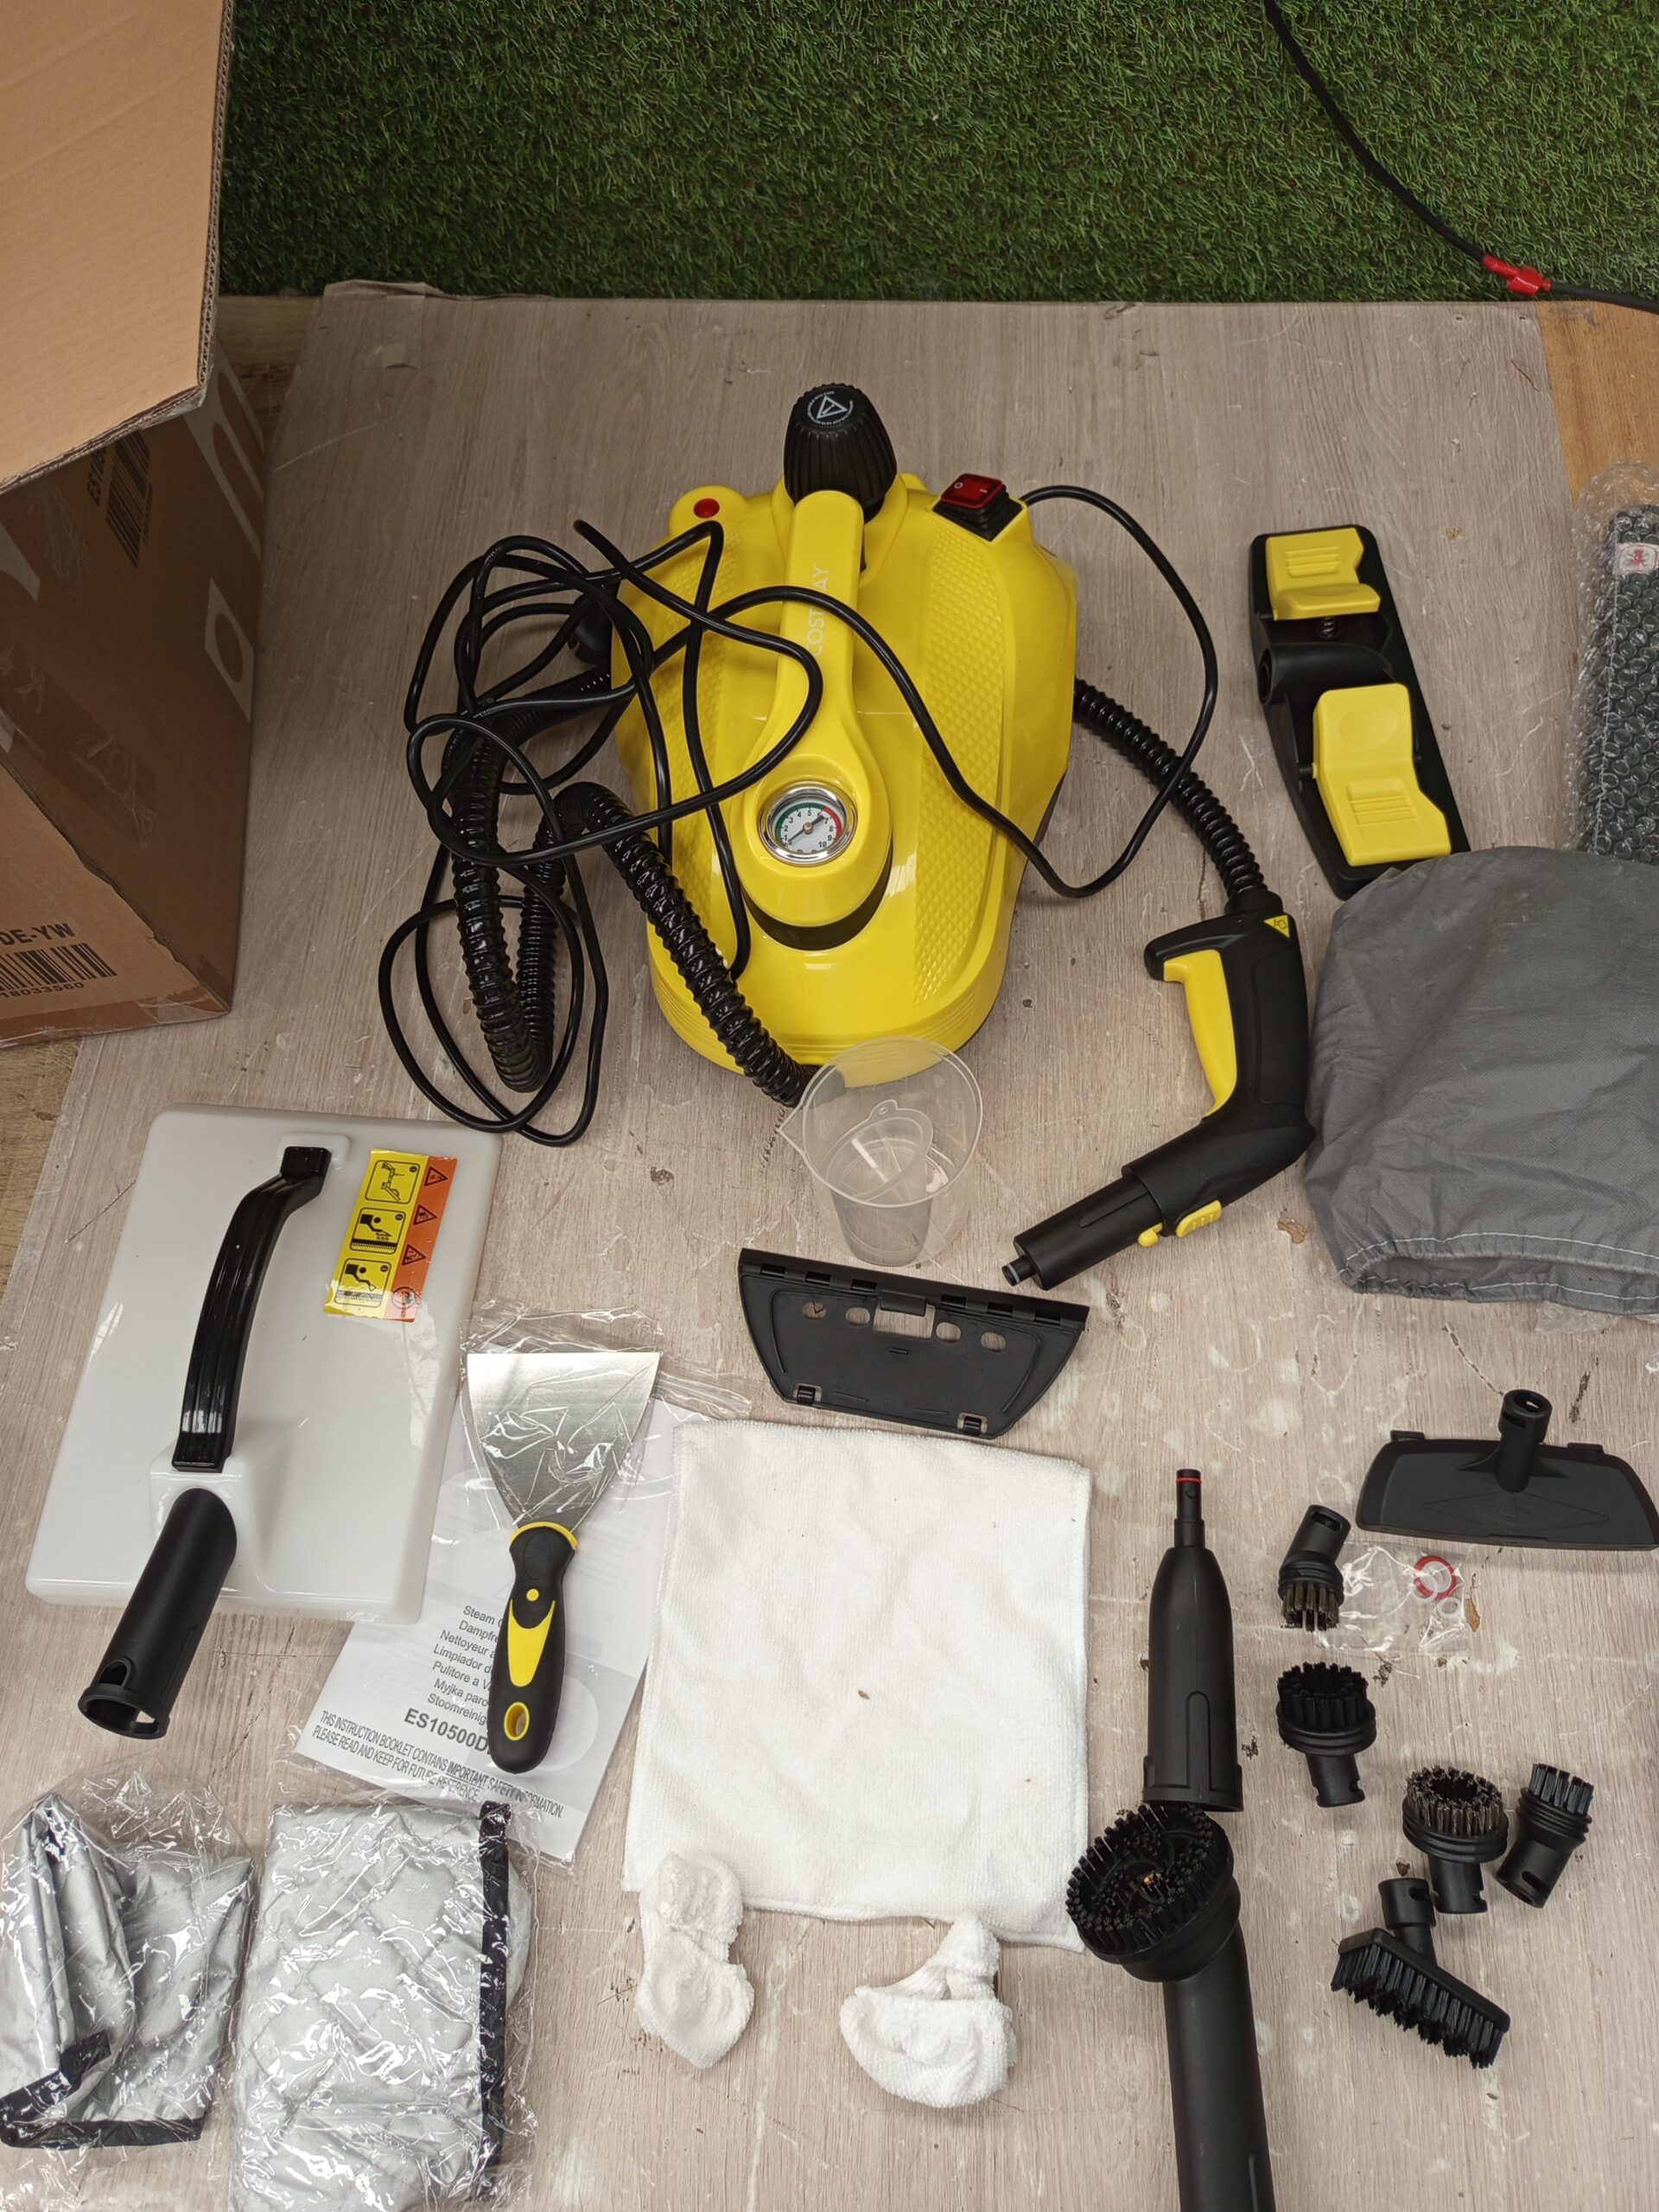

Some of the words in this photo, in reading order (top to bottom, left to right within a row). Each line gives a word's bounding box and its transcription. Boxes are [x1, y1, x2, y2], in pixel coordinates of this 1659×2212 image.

[806, 565, 830, 657] COSTAY
[463, 1605, 495, 1624] Steam
[433, 1643, 483, 1669] Limpiador
[484, 1664, 493, 1674] d
[440, 1630, 489, 1656] Nettoyeur
[432, 1661, 471, 1682] Pulitore
[483, 1679, 491, 1690] V
[434, 1678, 464, 1697] Myjka
[404, 1707, 490, 1754] ES10500D
[312, 1725, 340, 1745] PLEASE
[338, 1735, 359, 1753] READ
[356, 1743, 375, 1759] AND
[372, 1750, 394, 1766] KEEP
[392, 1757, 410, 1774] FOR
[408, 1763, 438, 1785] FUTURE
[320, 1710, 336, 1726] THIS
[334, 1716, 381, 1745] INSTRUCTION
[378, 1734, 414, 1756] BOOKLET
[412, 1747, 448, 1771] CONTAINS
[446, 1761, 488, 1788] IMPORTANT
[486, 1777, 517, 1798] SAFETY
[515, 1788, 564, 1818] INORMATION.
